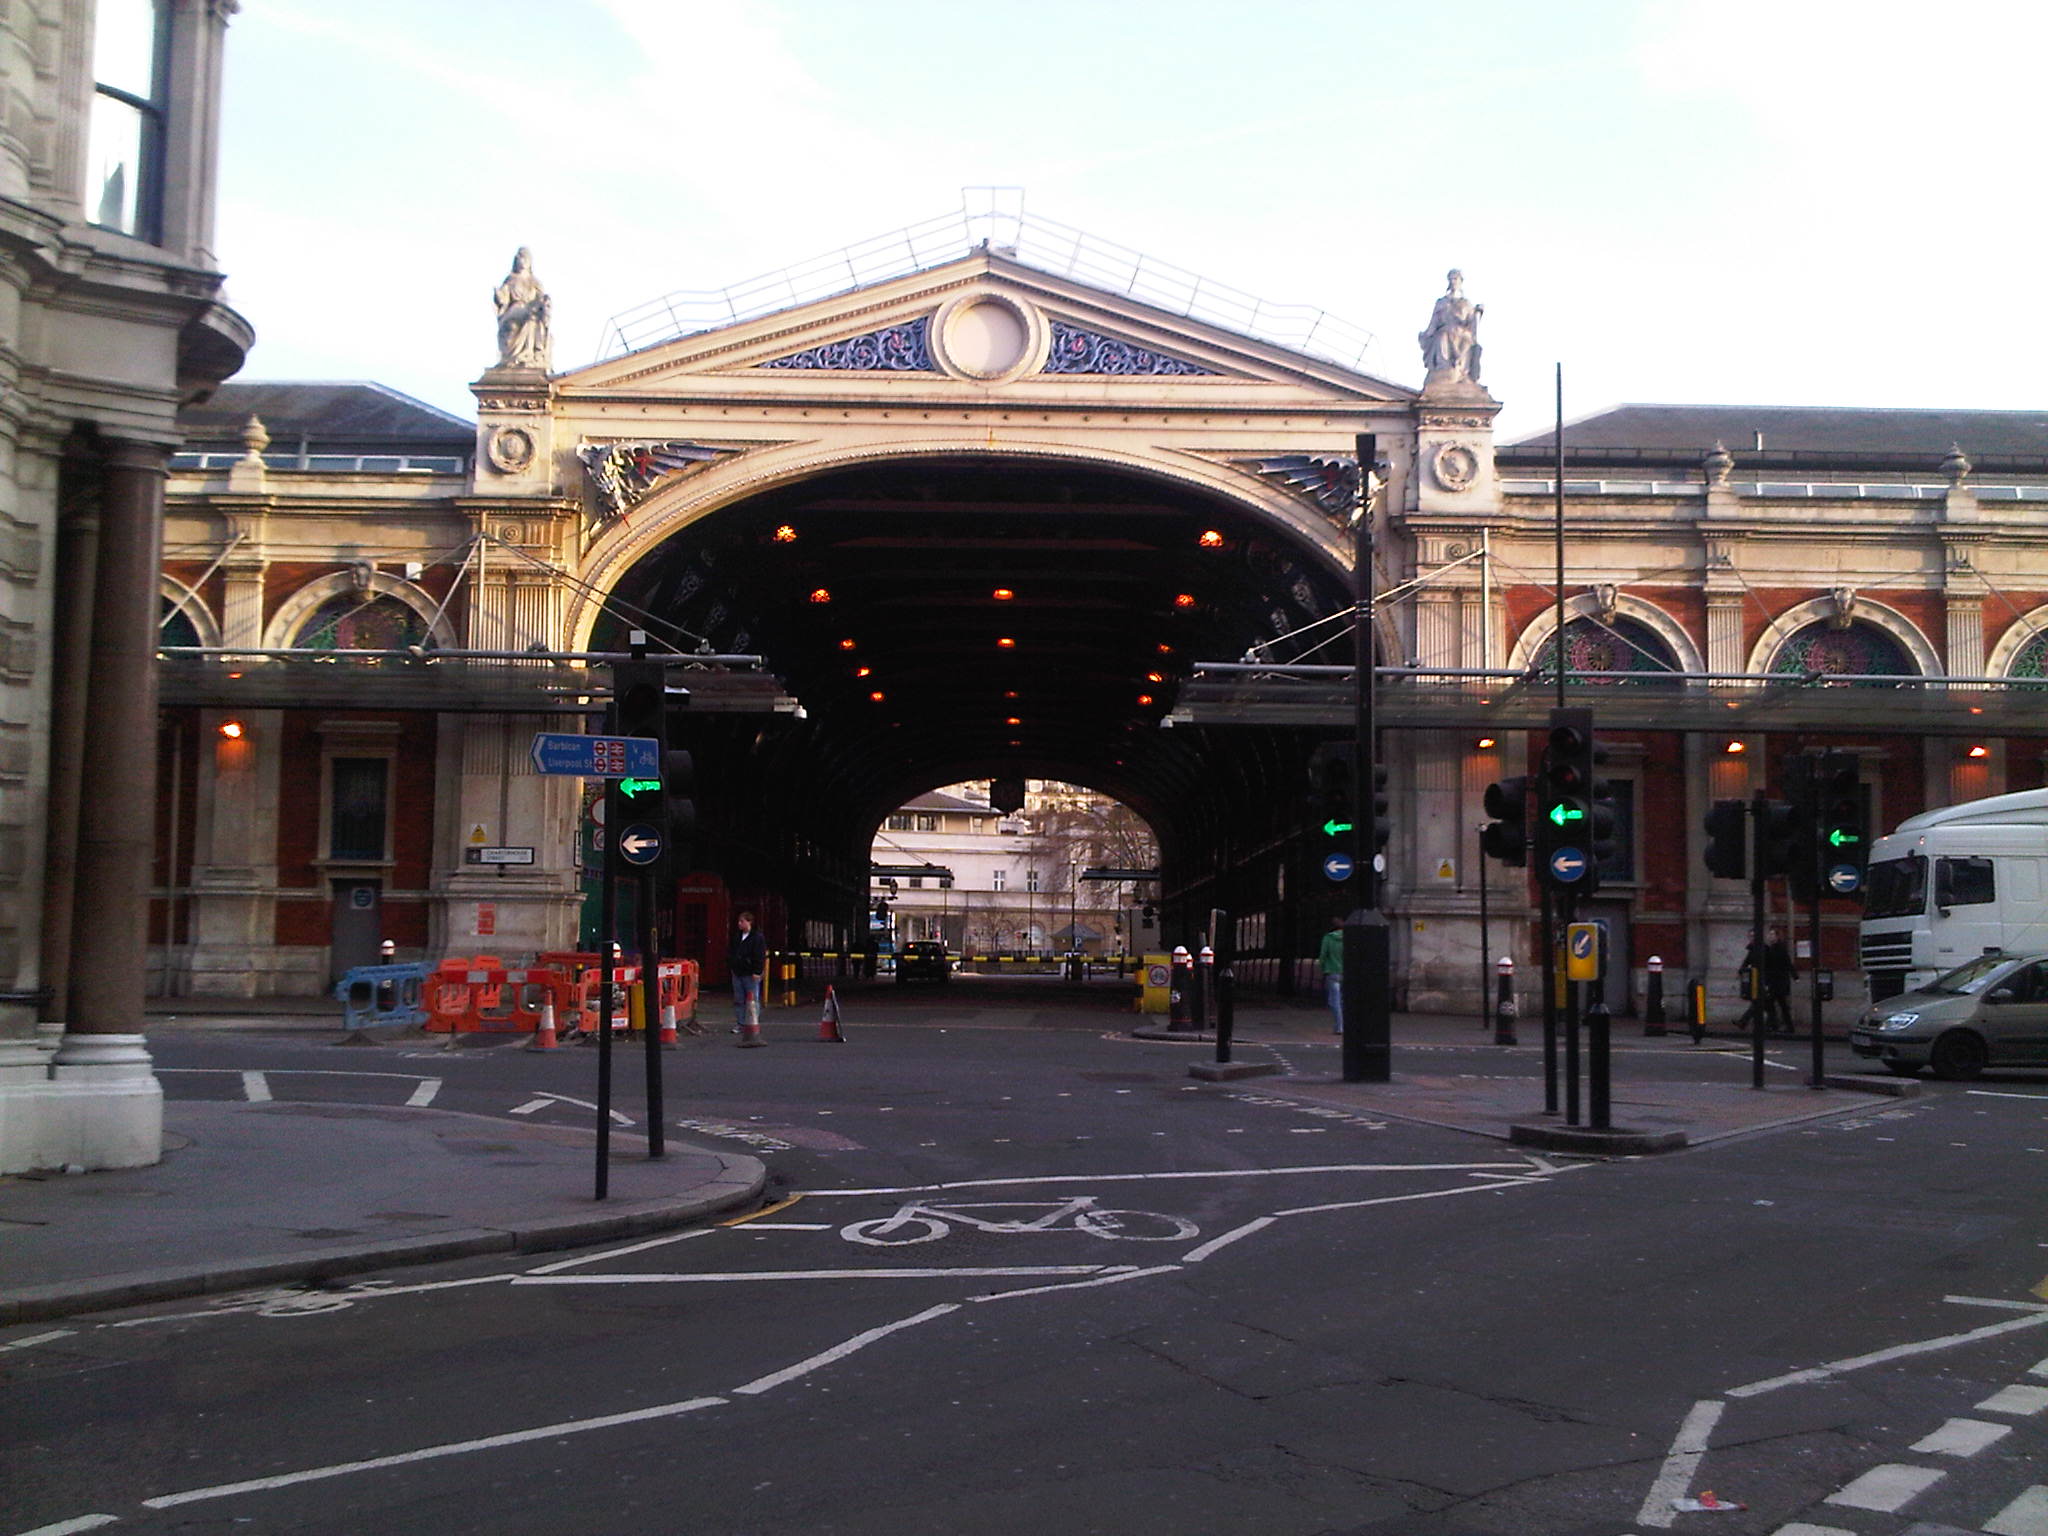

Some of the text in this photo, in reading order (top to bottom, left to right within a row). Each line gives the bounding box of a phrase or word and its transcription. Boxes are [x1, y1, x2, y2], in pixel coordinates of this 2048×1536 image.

[548, 740, 581, 751] Barbican
[548, 757, 593, 769] Liverpool St
